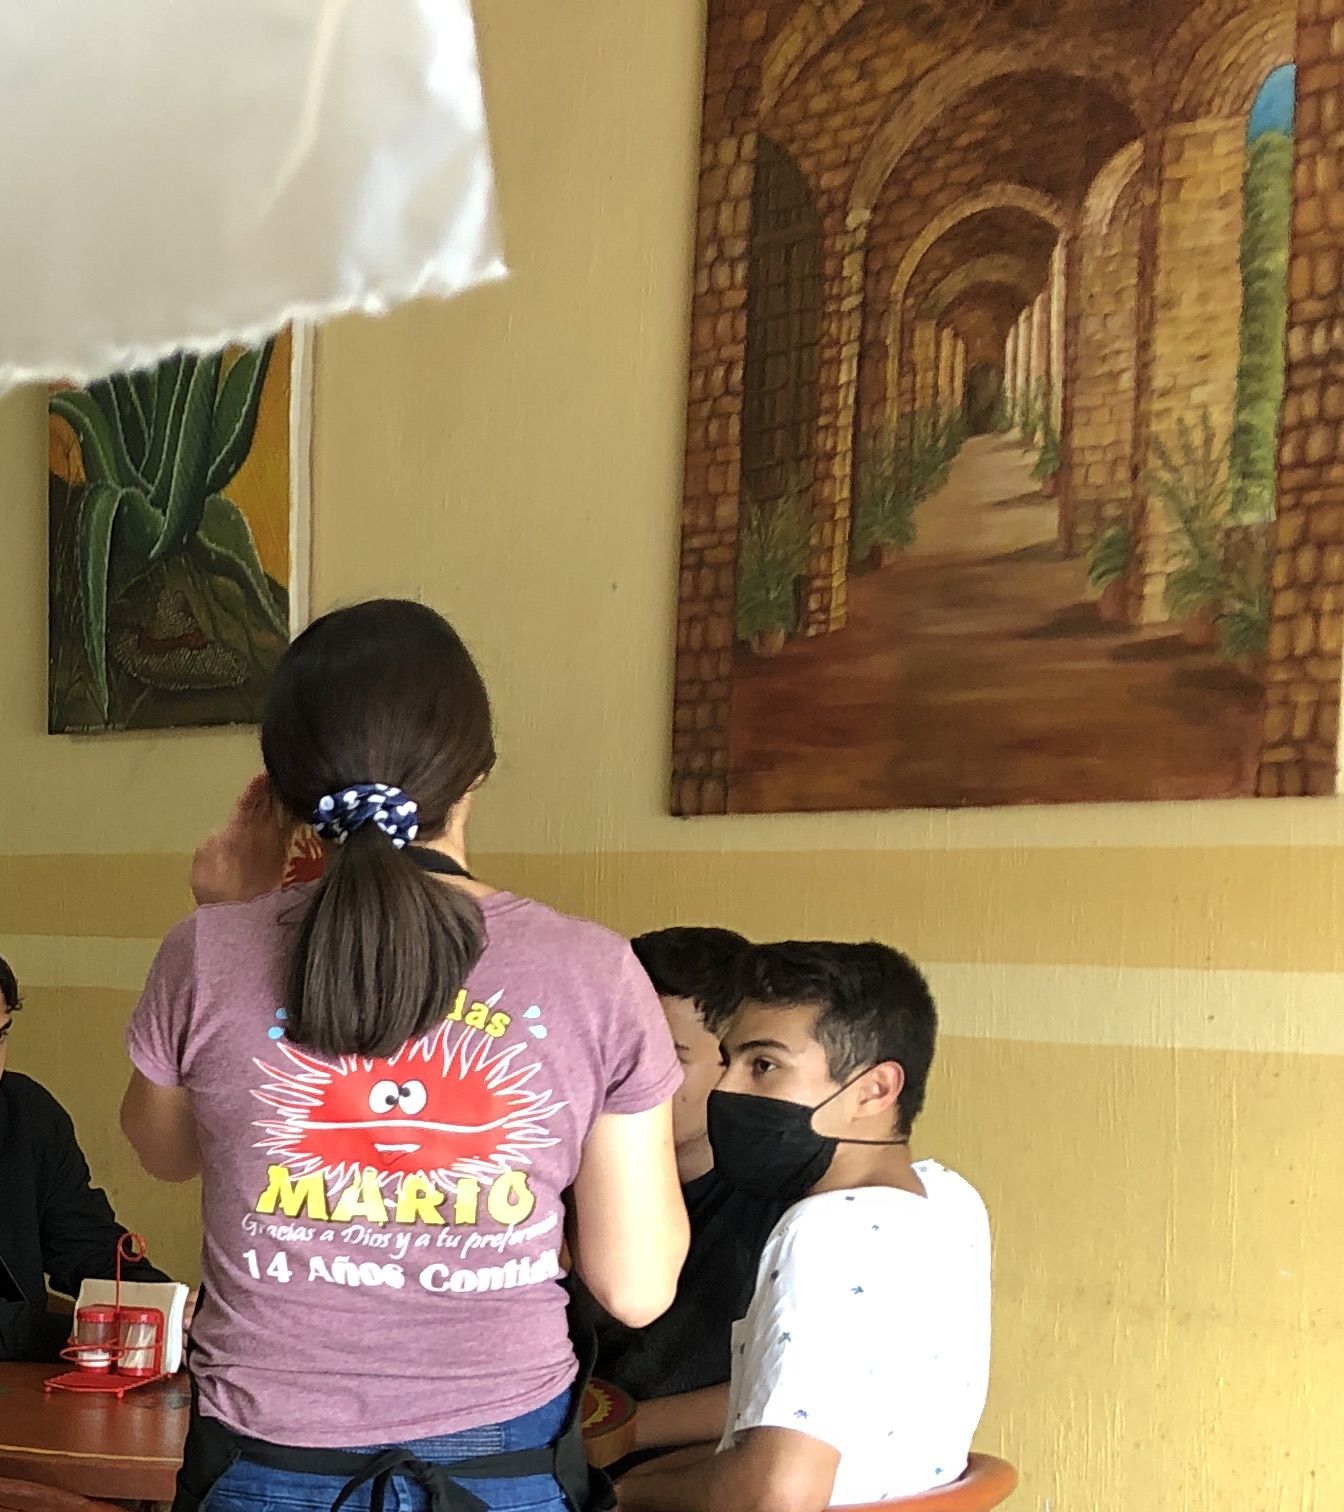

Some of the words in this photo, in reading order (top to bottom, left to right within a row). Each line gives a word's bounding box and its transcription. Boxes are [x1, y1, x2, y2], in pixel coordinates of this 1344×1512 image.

[254, 1164, 535, 1227] MARIO
[242, 1213, 316, 1242] Gracias
[319, 1229, 334, 1242] a
[341, 1225, 392, 1248] Dios
[389, 1232, 412, 1259] y
[414, 1233, 431, 1247] a
[436, 1226, 462, 1248] tu
[243, 1249, 292, 1283] 14
[308, 1255, 405, 1289] Años
